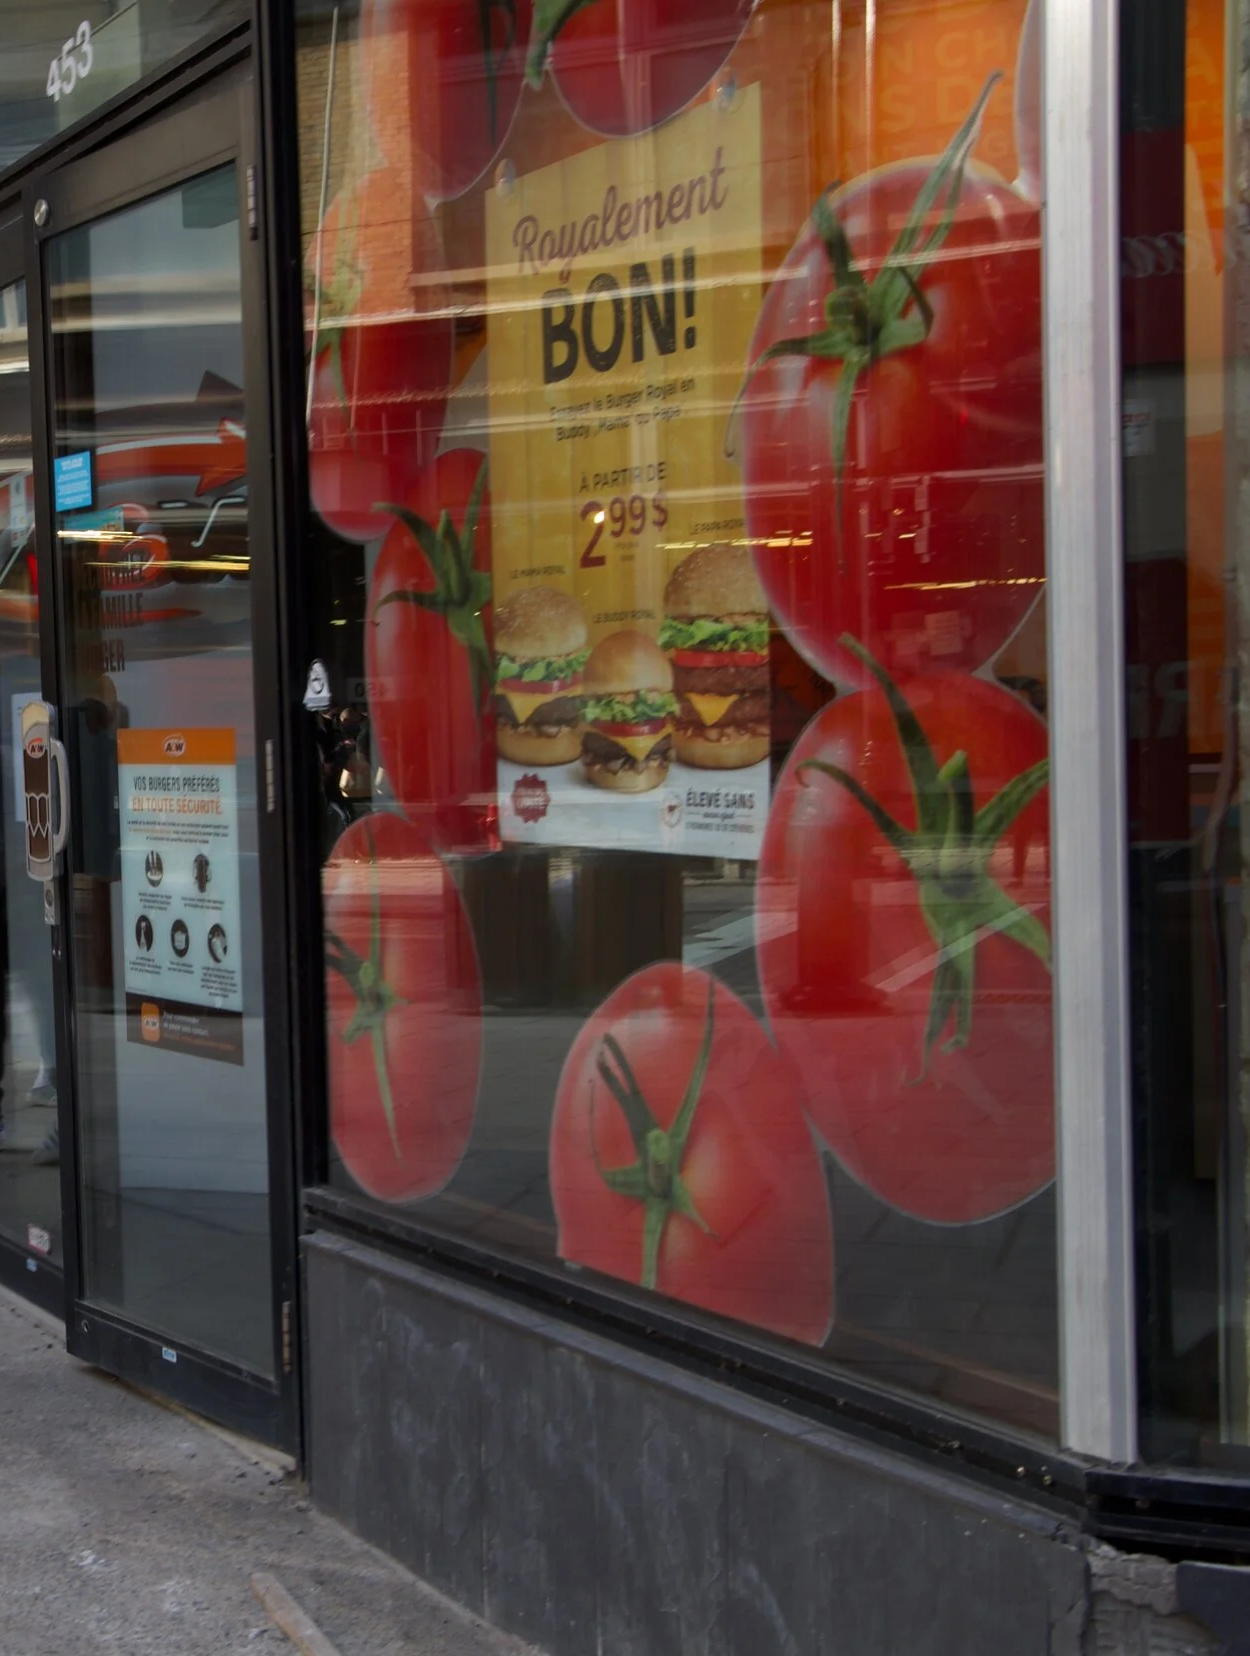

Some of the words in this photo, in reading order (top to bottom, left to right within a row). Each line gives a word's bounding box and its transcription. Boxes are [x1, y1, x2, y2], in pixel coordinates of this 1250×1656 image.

[46, 20, 93, 102] 453
[512, 147, 728, 284] Royalement
[541, 246, 696, 385] BON!
[646, 383, 676, 400] Royal
[579, 470, 590, 493] À
[593, 466, 642, 491] PARTIR
[647, 462, 667, 483] DE
[134, 775, 147, 791] VOS
[149, 776, 181, 793] BURGERS
[183, 774, 220, 793] PRÉFÉRÉS
[133, 797, 144, 812] EN
[147, 797, 174, 813] TOUTE
[686, 788, 721, 808] ÉLEVÉ
[724, 793, 755, 809] SANS
